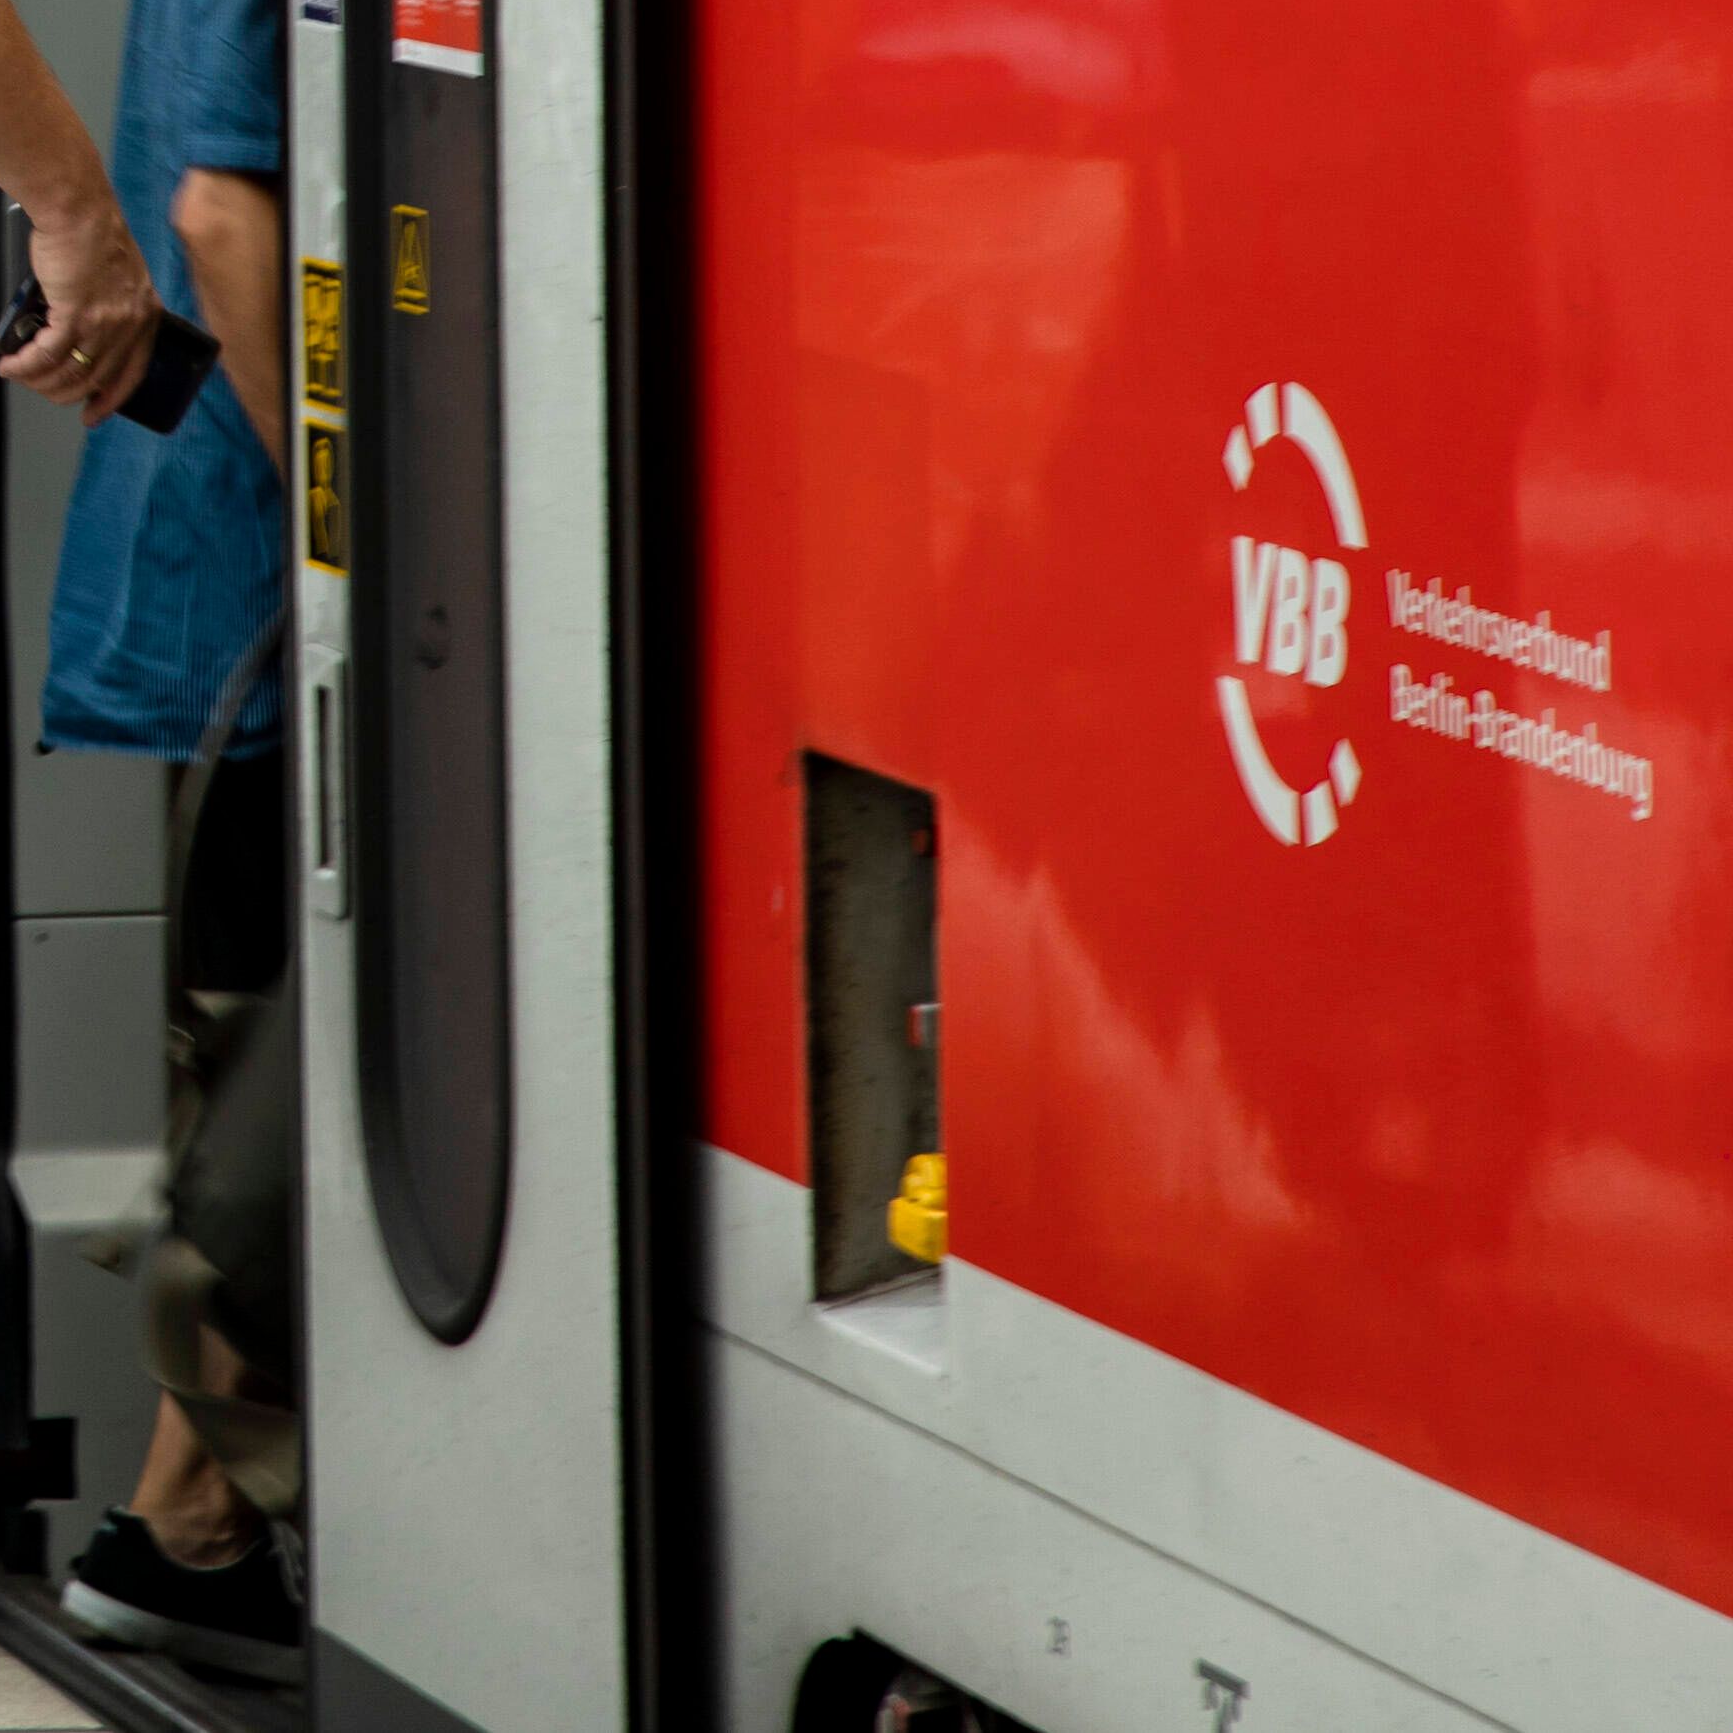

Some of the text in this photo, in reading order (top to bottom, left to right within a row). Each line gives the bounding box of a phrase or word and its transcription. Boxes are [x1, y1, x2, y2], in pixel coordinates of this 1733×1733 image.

[1231, 534, 1351, 688] VBB
[1385, 568, 1613, 693] Verkehrsverbund
[1389, 663, 1654, 821] Berlin-Brandenburg
